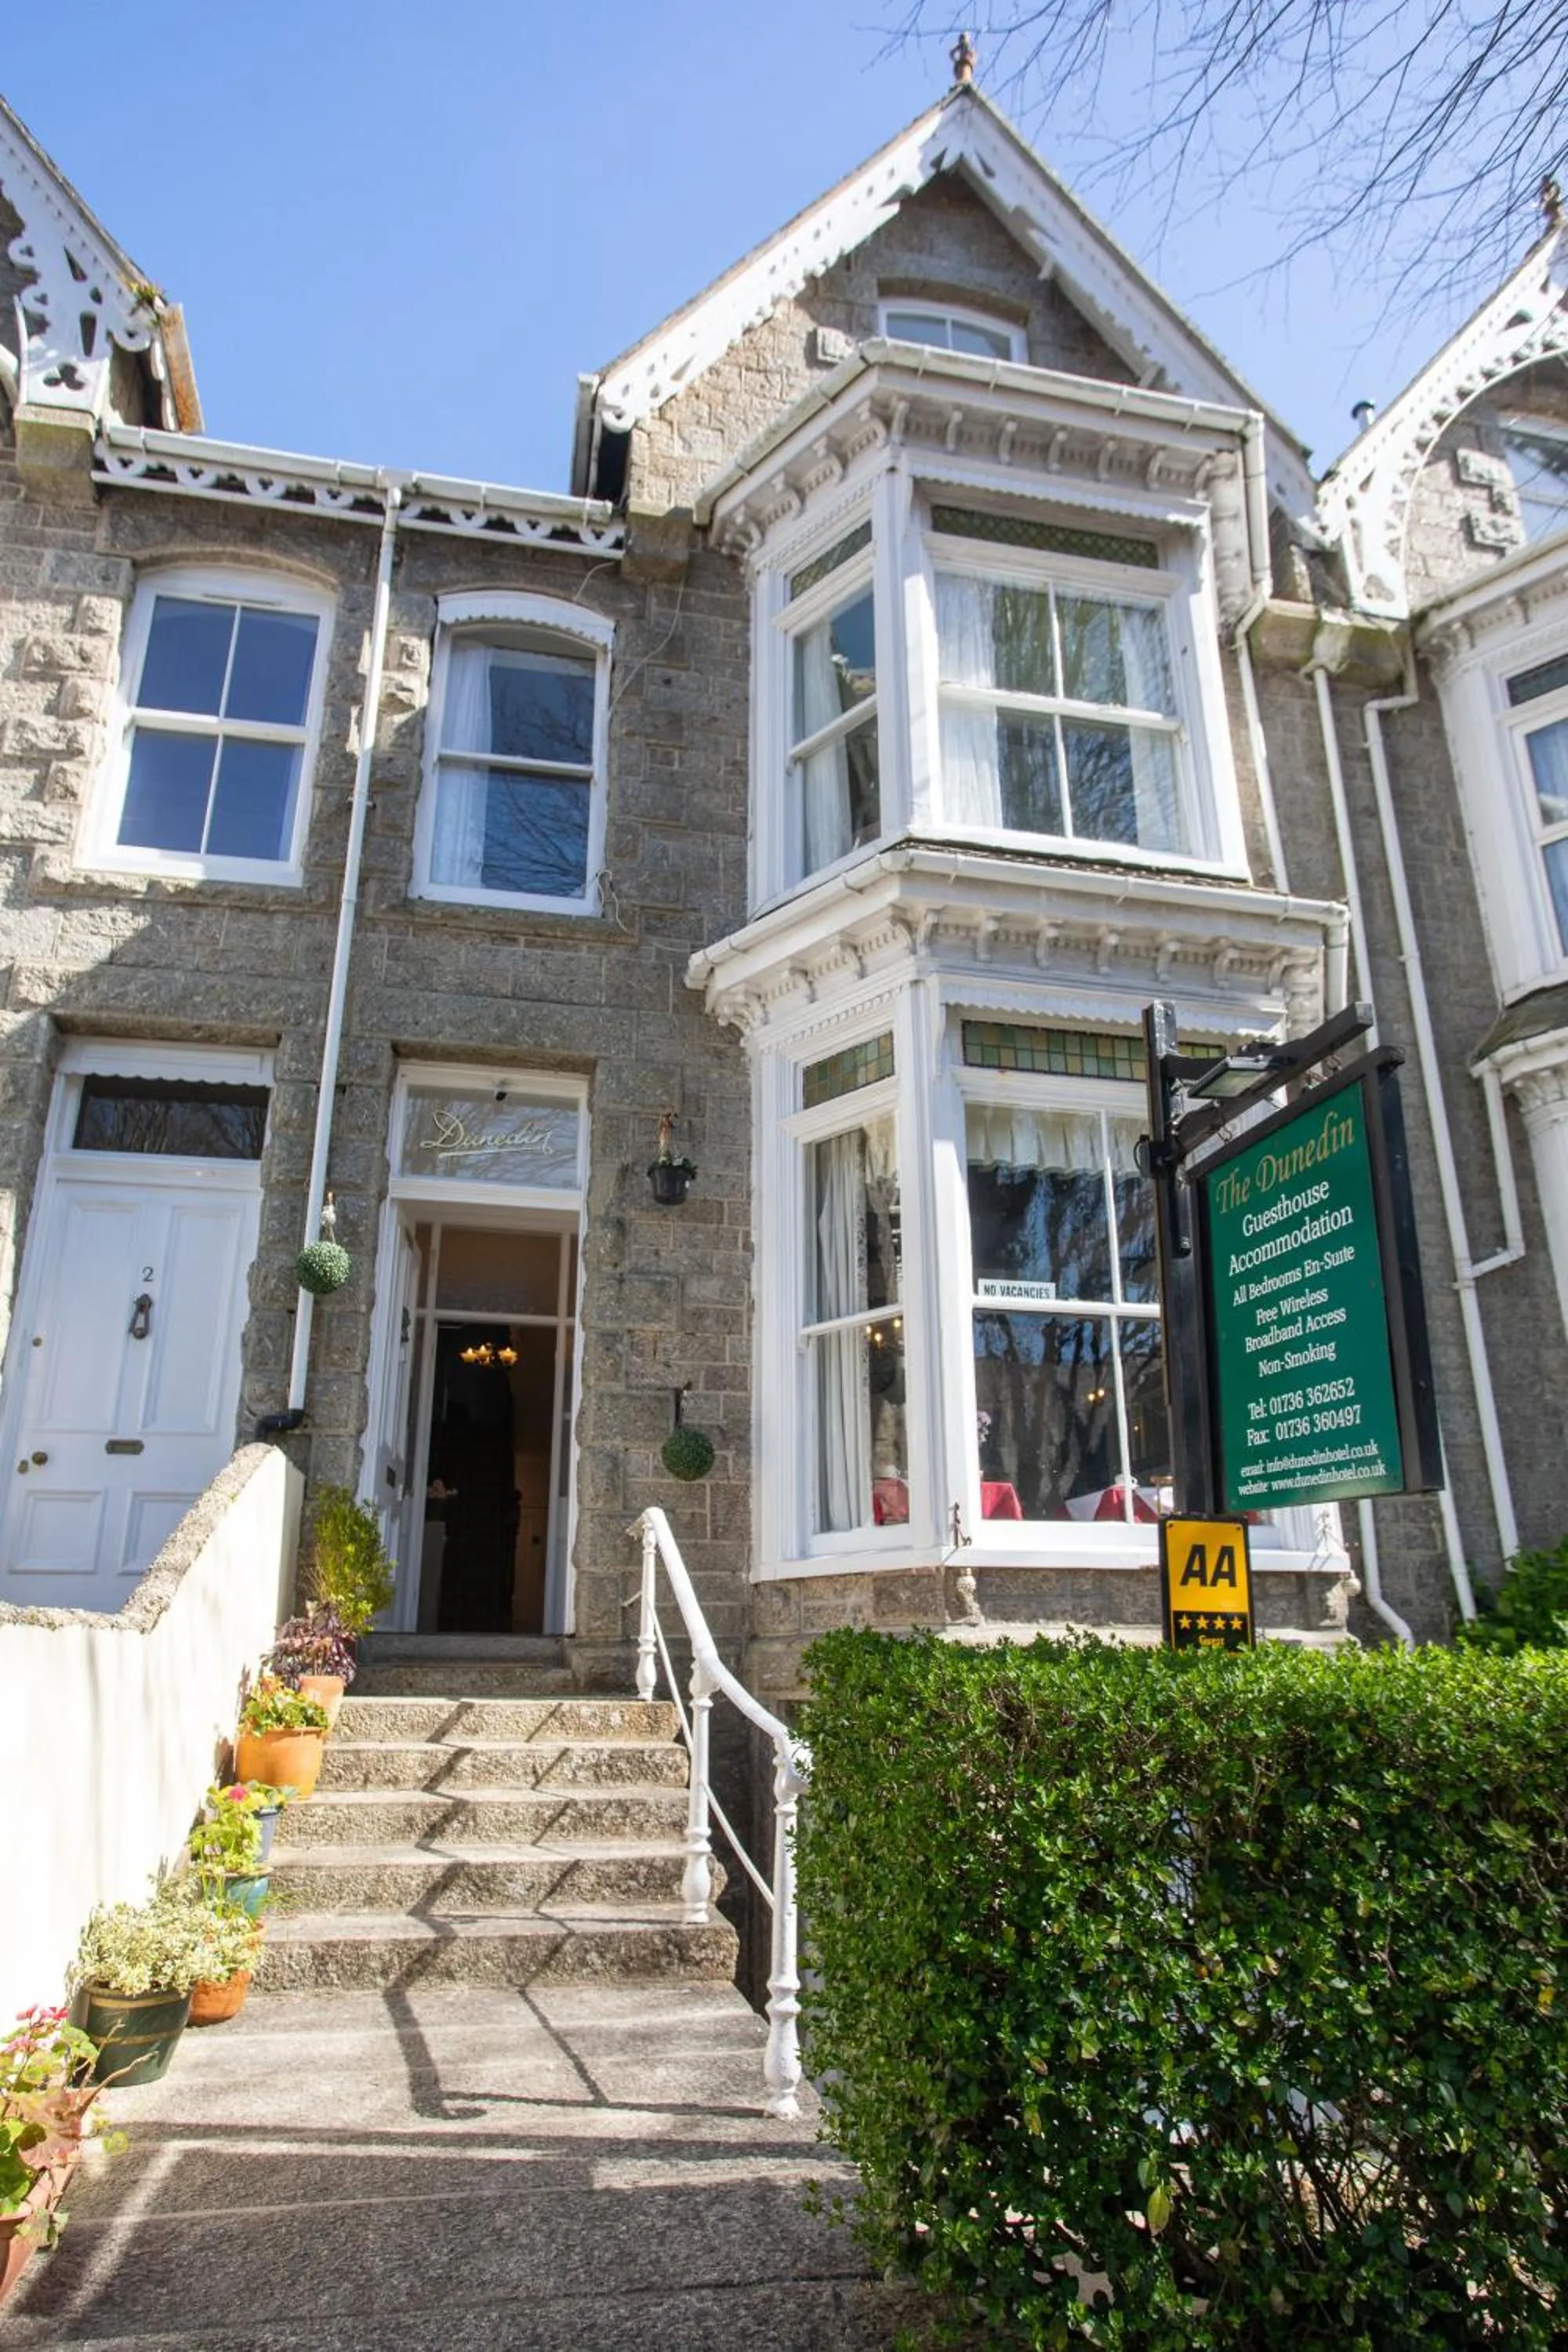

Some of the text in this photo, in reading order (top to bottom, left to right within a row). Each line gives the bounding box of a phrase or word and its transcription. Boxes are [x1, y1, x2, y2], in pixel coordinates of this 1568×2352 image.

[420, 1109, 554, 1156] Dunedin
[1217, 1110, 1355, 1214] The Dunedin
[1243, 1181, 1330, 1236] Guesthouse
[1229, 1206, 1354, 1276] Accommodation
[142, 1266, 154, 1282] 2
[984, 1283, 1051, 1299] NO VACANCIES
[1232, 1246, 1355, 1307] All Bedrooms En-Suite
[1256, 1288, 1328, 1326] Free Wireless
[1245, 1307, 1346, 1353] Broadband Access
[1258, 1341, 1336, 1377] Non-Smoking
[1248, 1377, 1355, 1420] Tel: 01736 362652
[1247, 1404, 1361, 1446] Fax: 01736 360497
[1266, 1439, 1379, 1473] info@dunedinhotel.co.uk
[1271, 1459, 1386, 1491] www.dunedinhotel.co.uk
[1179, 1544, 1237, 1588] AA
